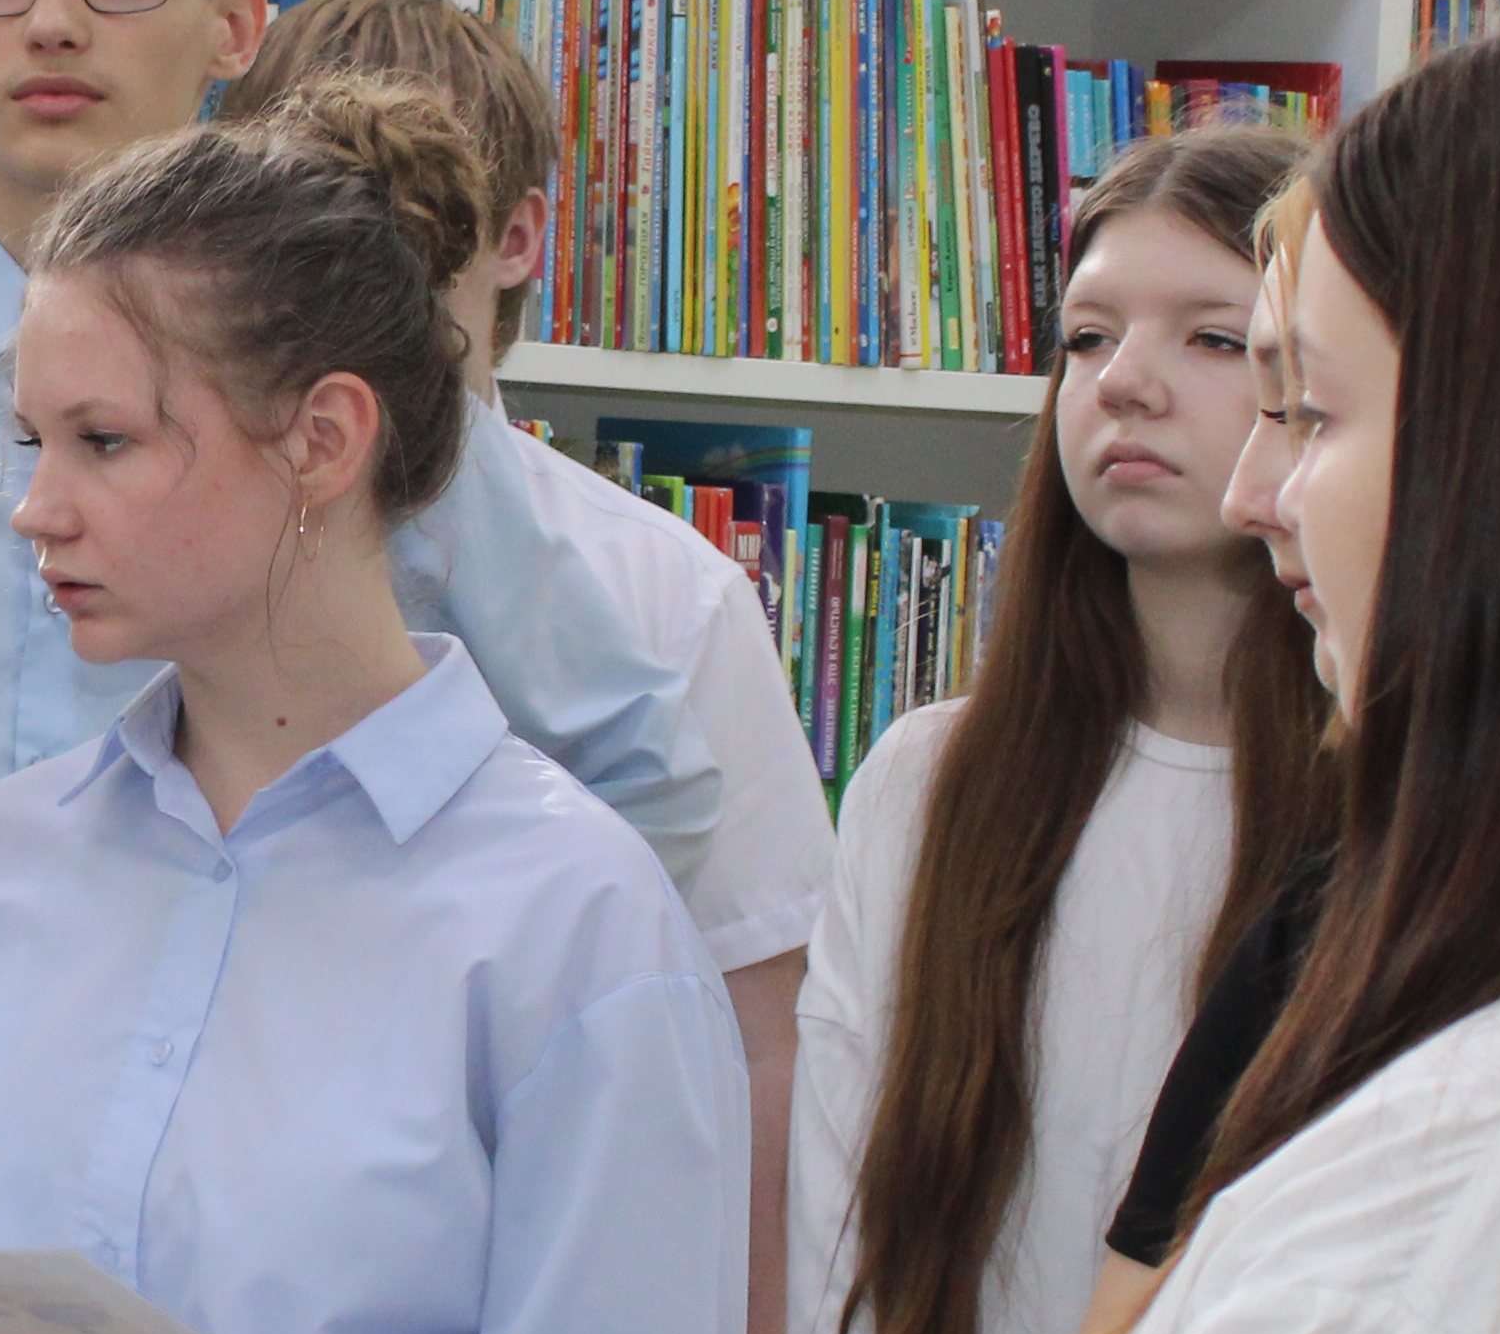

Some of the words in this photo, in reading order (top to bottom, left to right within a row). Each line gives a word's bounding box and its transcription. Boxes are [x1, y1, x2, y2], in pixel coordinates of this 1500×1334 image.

[640, 126, 654, 176] Тайна
[1026, 103, 1045, 183] ДЕРЕВО
[828, 595, 841, 651] СЧАСТЬЮ
[826, 663, 838, 685] ЭТО
[822, 698, 836, 772] ПРИВИДЕНИЕ
